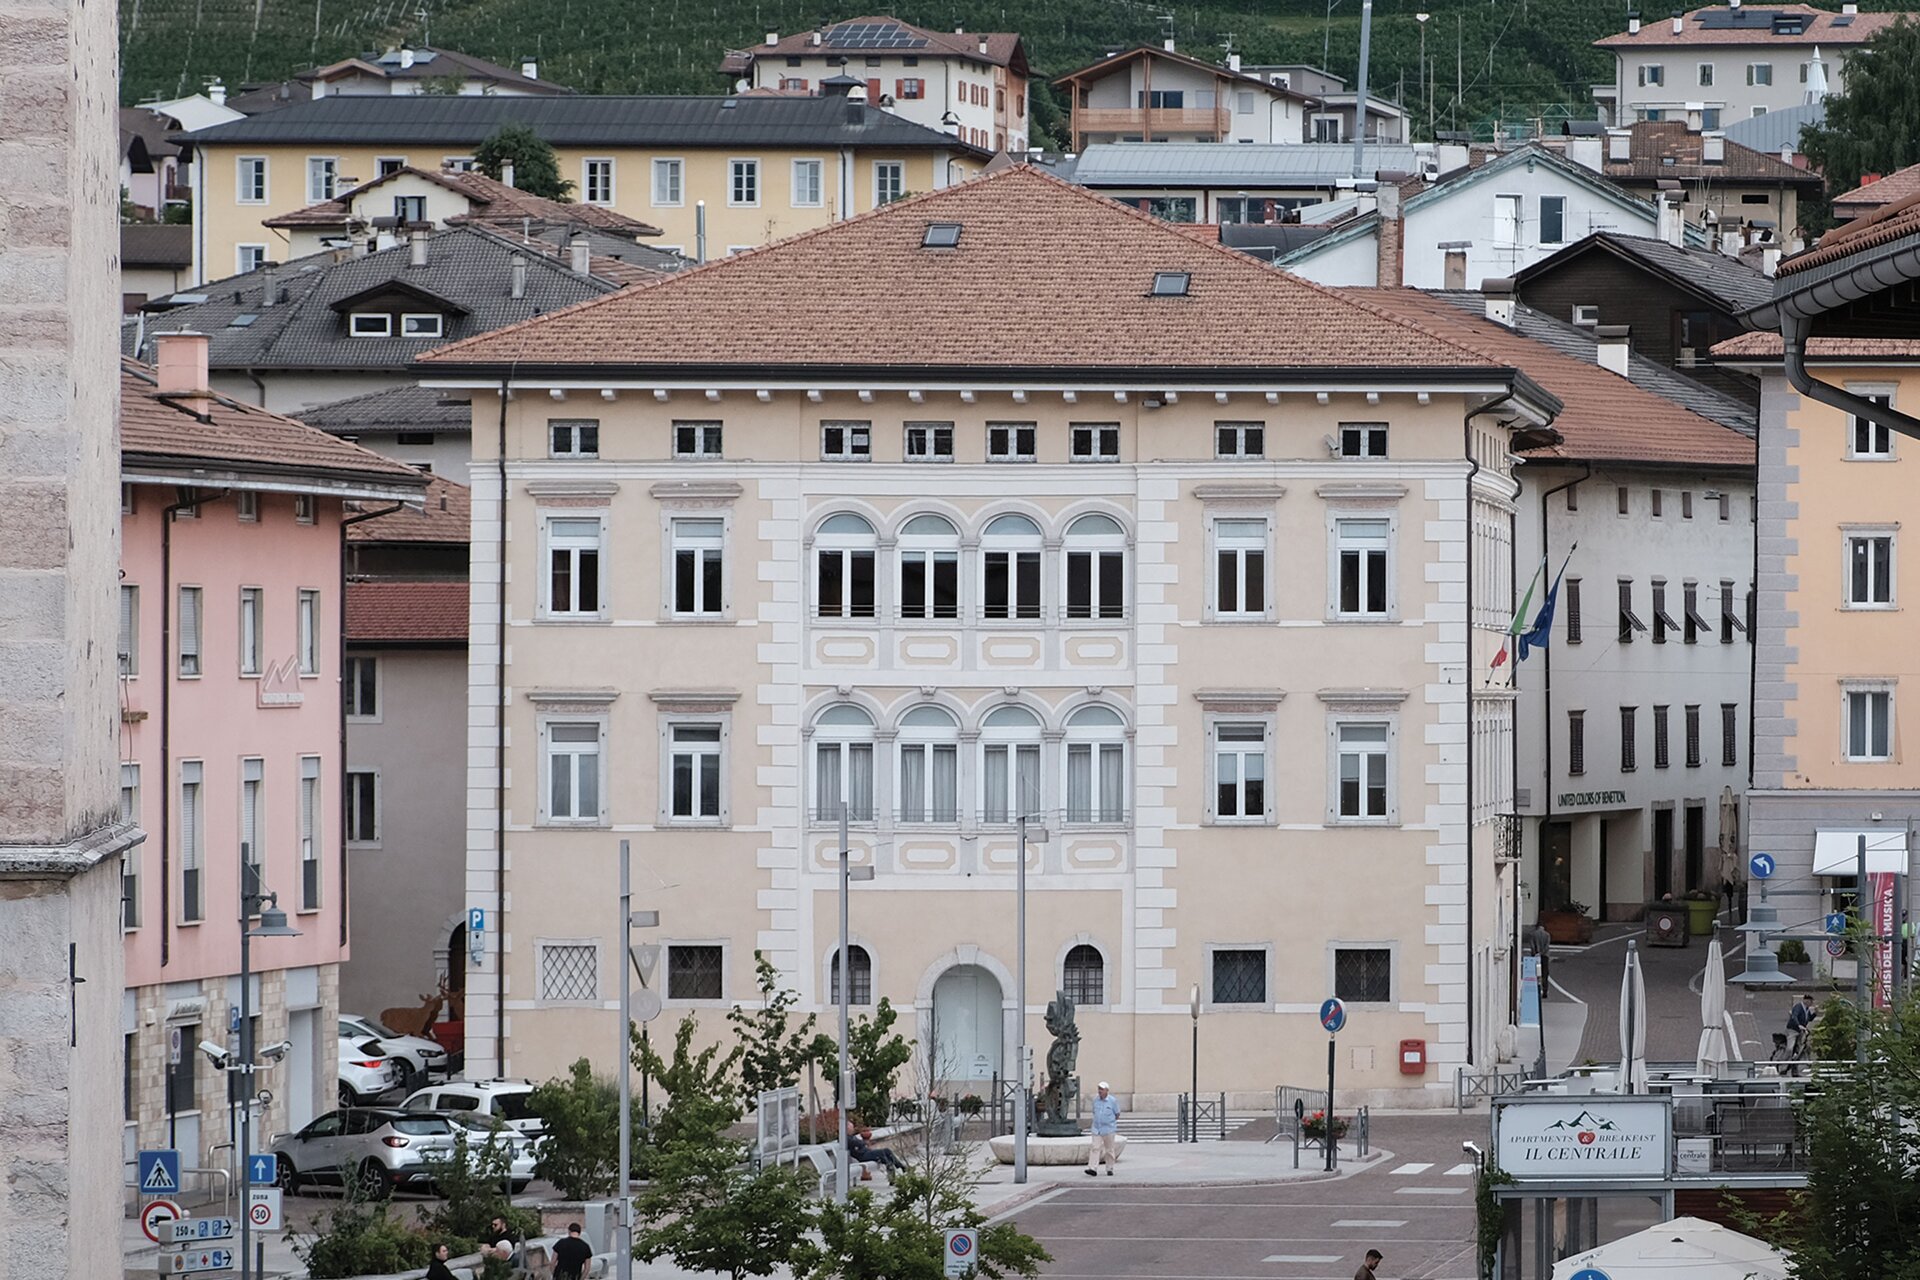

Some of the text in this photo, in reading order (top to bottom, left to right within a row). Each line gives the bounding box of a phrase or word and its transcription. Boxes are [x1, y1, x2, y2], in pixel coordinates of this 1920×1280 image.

[1558, 793, 1575, 807] UNITED
[1576, 791, 1594, 806] COLORS
[1595, 791, 1602, 805] OF
[1883, 888, 1893, 932] MUSICA
[472, 911, 482, 928] P
[1508, 1135, 1575, 1143] APARTMENTS
[1598, 1134, 1657, 1142] BREAKFAST
[1525, 1147, 1642, 1161] IL CENTRALE
[1679, 1151, 1707, 1160] centrale
[255, 1209, 266, 1220] 30
